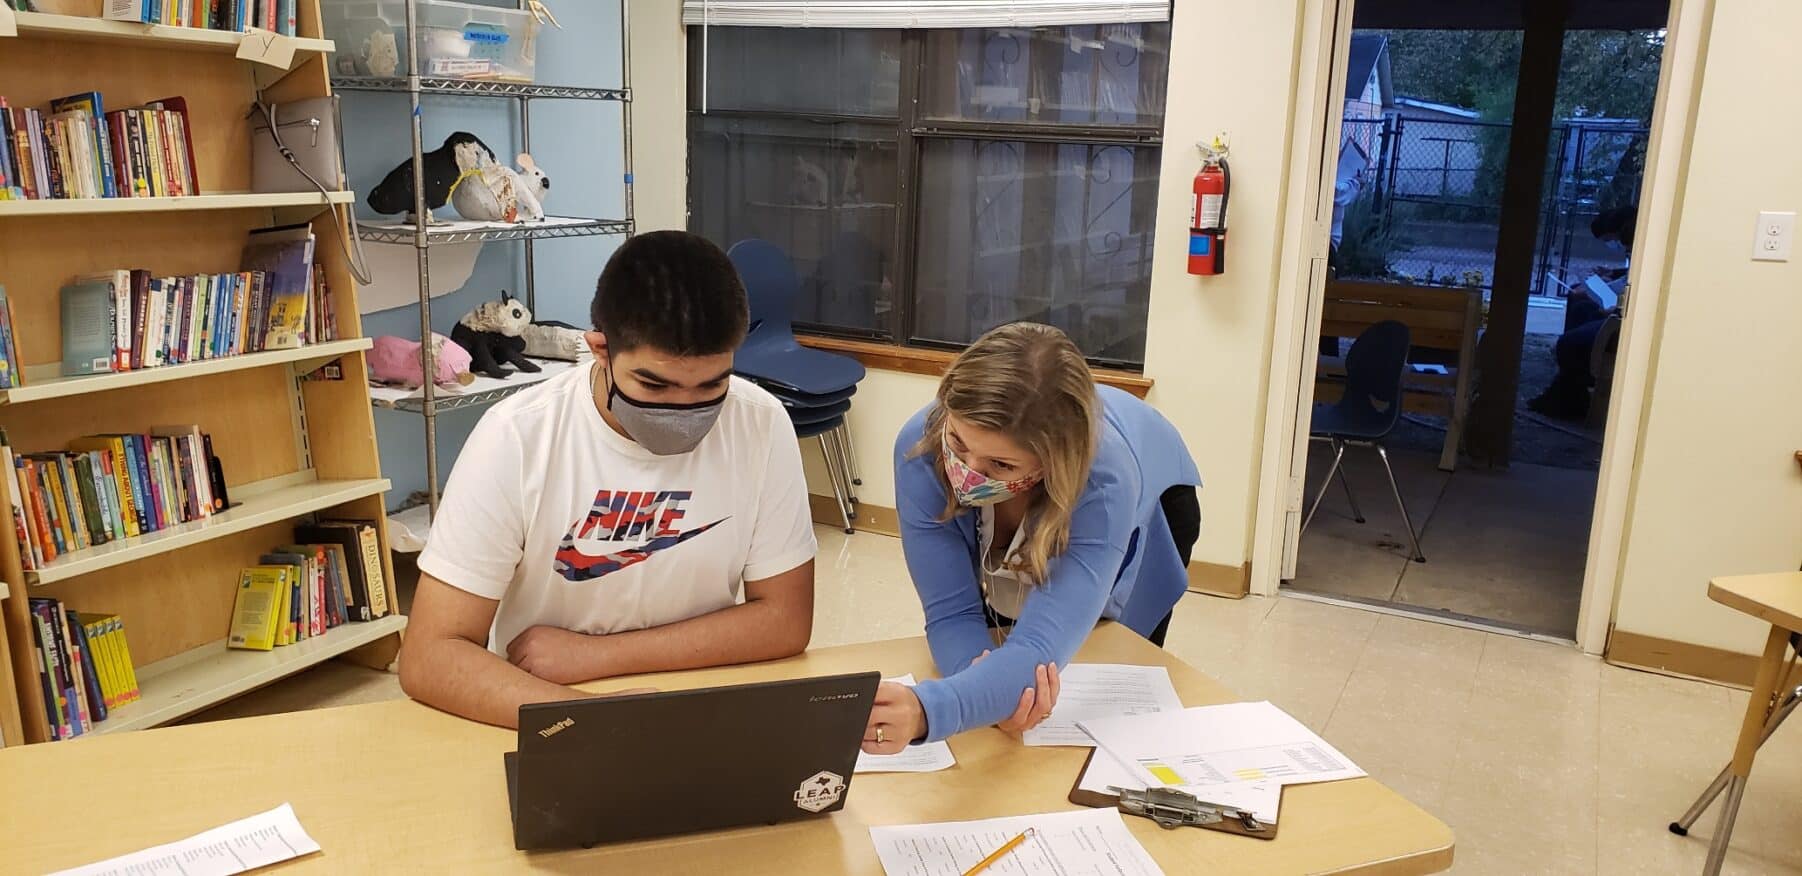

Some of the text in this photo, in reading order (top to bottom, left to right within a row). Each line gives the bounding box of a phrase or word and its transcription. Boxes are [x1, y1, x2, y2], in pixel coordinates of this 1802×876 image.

[577, 490, 692, 541] NIKE
[368, 544, 383, 607] DINOSAURS
[537, 716, 575, 738] ThinkPad
[796, 785, 845, 800] LEAP
